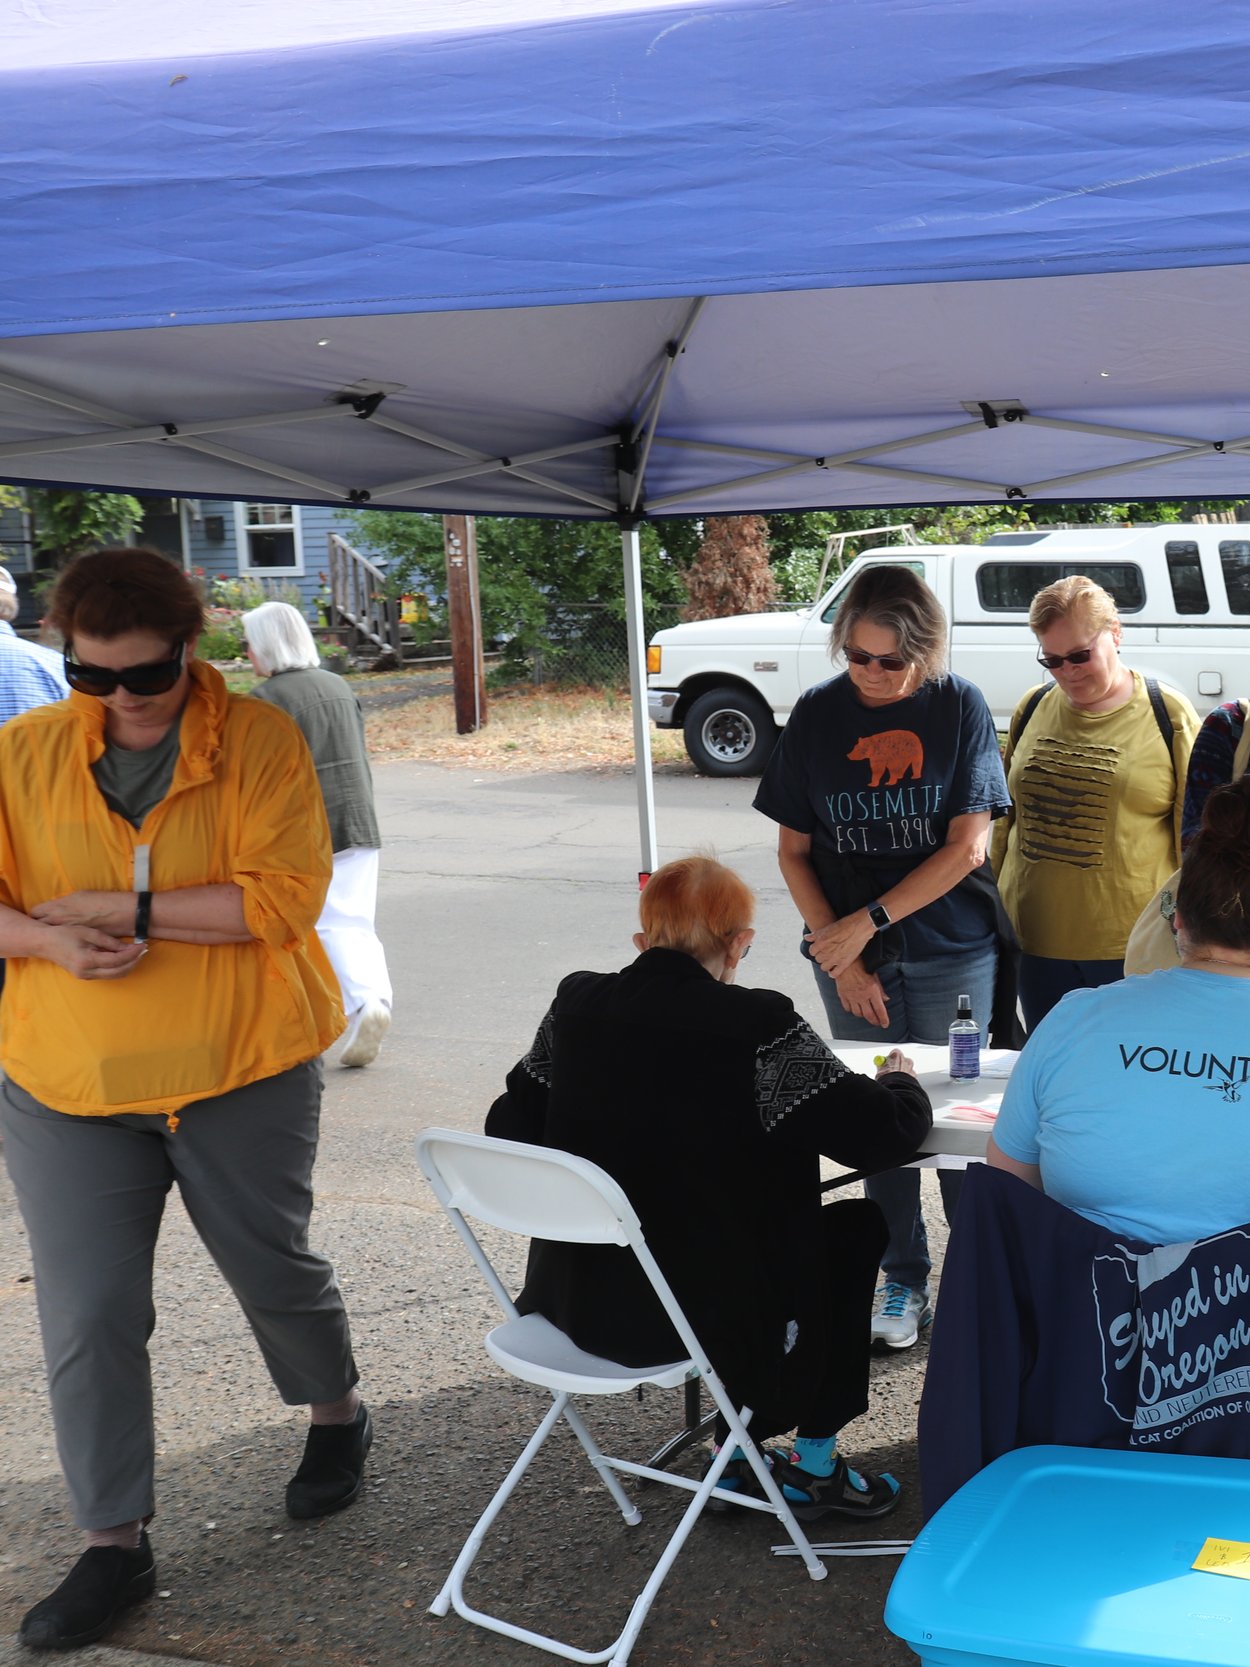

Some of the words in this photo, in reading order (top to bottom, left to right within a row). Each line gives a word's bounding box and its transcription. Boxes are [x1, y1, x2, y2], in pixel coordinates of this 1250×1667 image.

[825, 785, 944, 824] YOSEMITE
[836, 825, 878, 854] EST.
[886, 817, 937, 849] 1890
[1213, 1263, 1250, 1306] in
[1138, 1318, 1250, 1405] Oregon
[1133, 1408, 1161, 1426] ND
[1138, 1432, 1161, 1445] CAT
[1163, 1404, 1226, 1440] COALITION
[1226, 1400, 1243, 1415] OF
